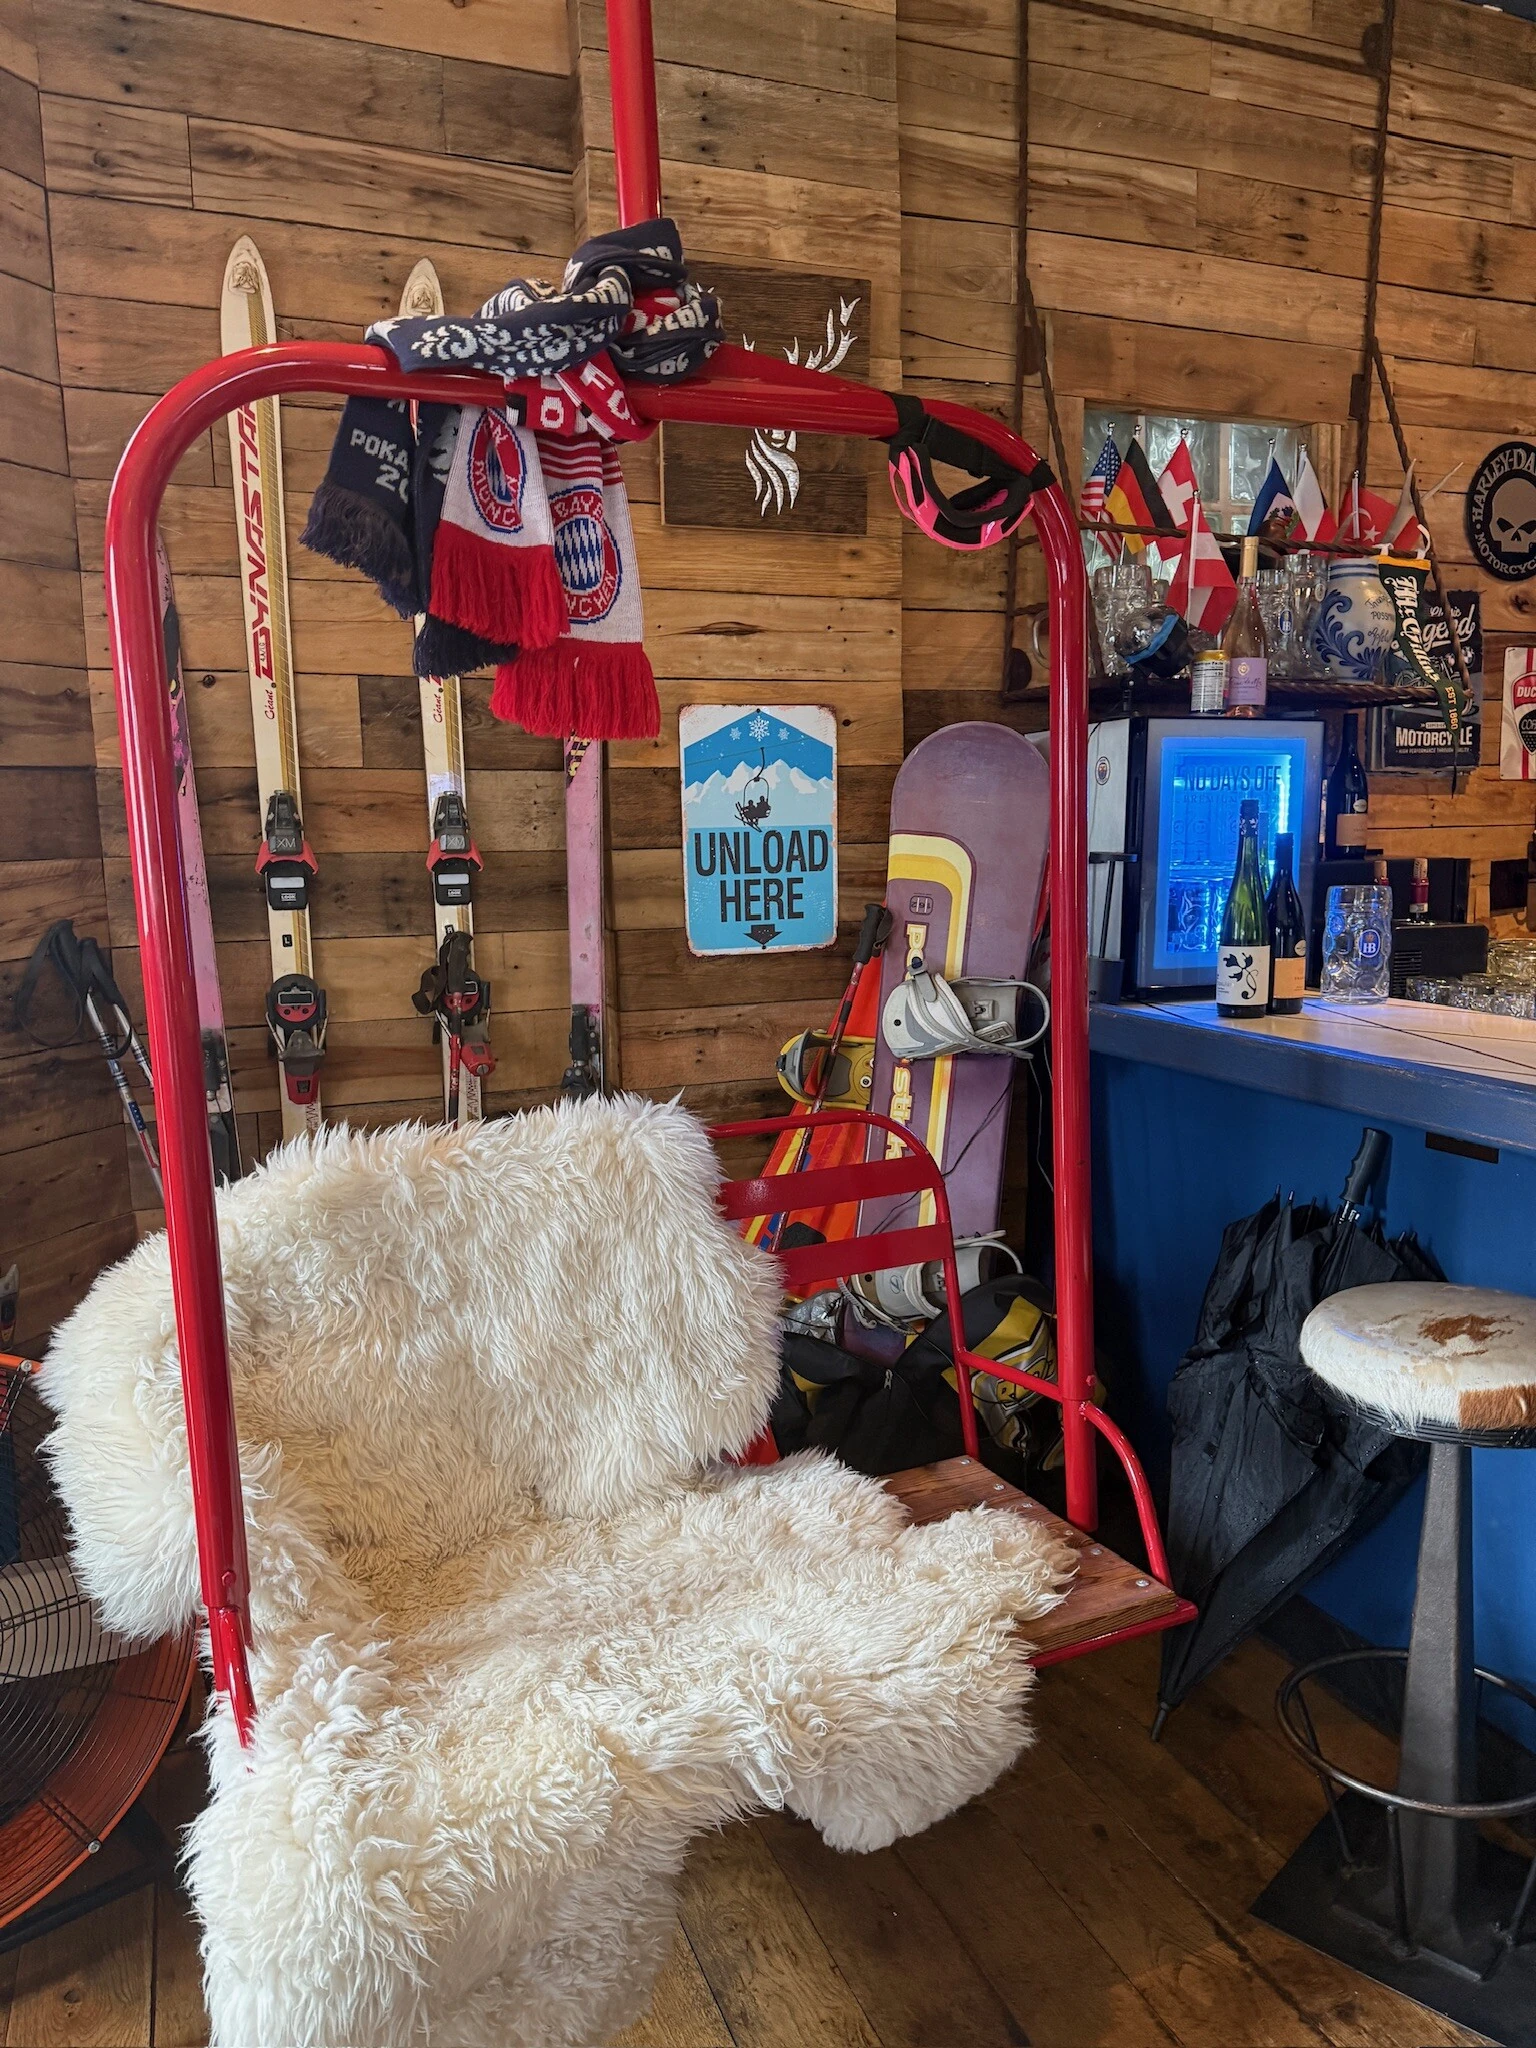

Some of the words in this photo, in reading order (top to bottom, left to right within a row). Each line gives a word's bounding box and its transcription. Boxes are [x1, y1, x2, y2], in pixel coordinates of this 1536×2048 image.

[1396, 726, 1473, 747] MOTORCYLE
[1210, 766, 1250, 791] DAYS
[1254, 765, 1282, 791] OFF
[277, 837, 296, 848] XM
[447, 836, 465, 847] XM
[694, 829, 829, 877] UNLOAD
[720, 877, 804, 923] HERE
[284, 936, 290, 944] L
[1363, 942, 1376, 953] HB
